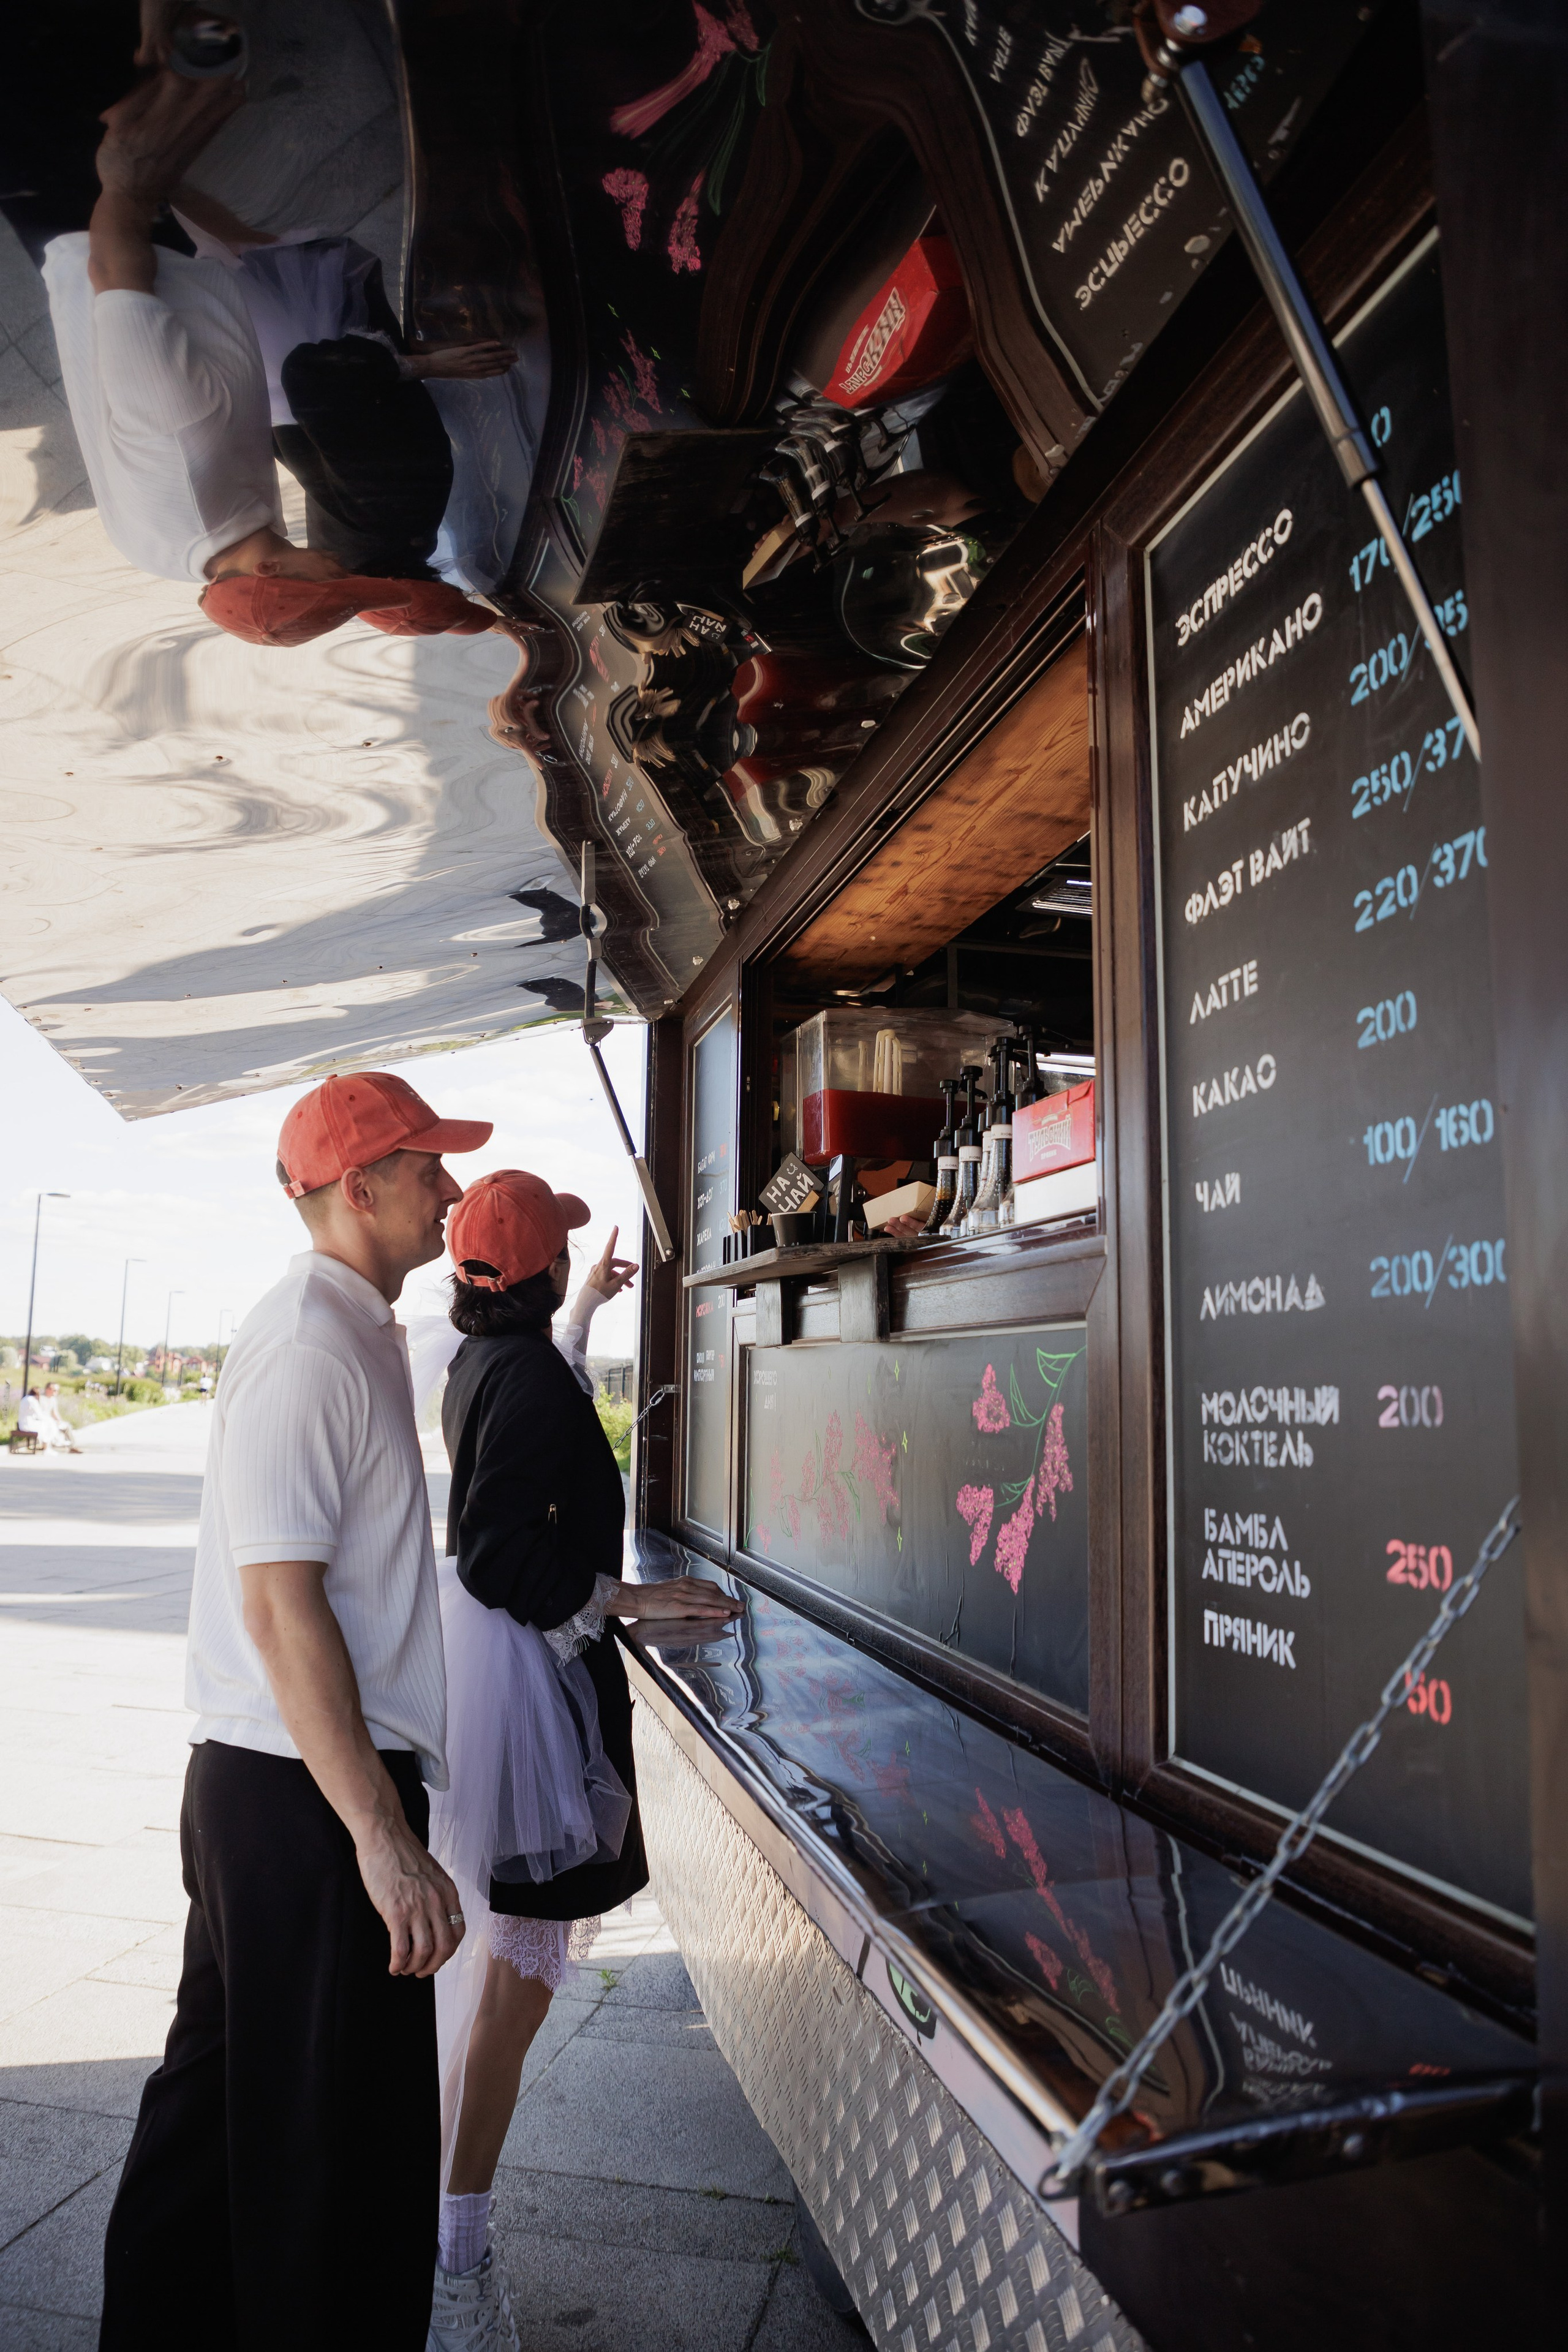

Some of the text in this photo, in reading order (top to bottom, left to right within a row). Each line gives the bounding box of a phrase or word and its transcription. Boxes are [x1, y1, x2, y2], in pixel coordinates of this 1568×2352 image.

[1175, 509, 1292, 647] ЭСПРЕССО
[1180, 593, 1322, 739] АМЕРИКАНО
[1185, 712, 1310, 831] КАПУЧИНО
[1185, 859, 1245, 925] ФЛЭТ
[1190, 960, 1259, 1025] ЛАТТЕ
[1356, 990, 1417, 1049] 200
[1193, 1054, 1276, 1117] КАКАО
[1028, 1114, 1072, 1163] ТУЛЬСКИЙ
[1363, 1093, 1494, 1183] 100/160
[766, 1176, 790, 1204] НА
[778, 1172, 814, 1212] ЧАЙ
[1196, 1172, 1240, 1213] ЧАЙ
[1200, 1273, 1325, 1321] ЛИМОНАД
[1202, 1385, 1340, 1426] МОЛОЧНЫЙ
[1377, 1385, 1443, 1428] 200
[1204, 1430, 1314, 1468] КОКТЕЛЬ
[1205, 1508, 1288, 1551] БАМБЛ
[1202, 1548, 1311, 1599] АПЕРОЛЬ
[1385, 1539, 1453, 1592] 250
[1204, 1609, 1296, 1669] ПРЯНИК
